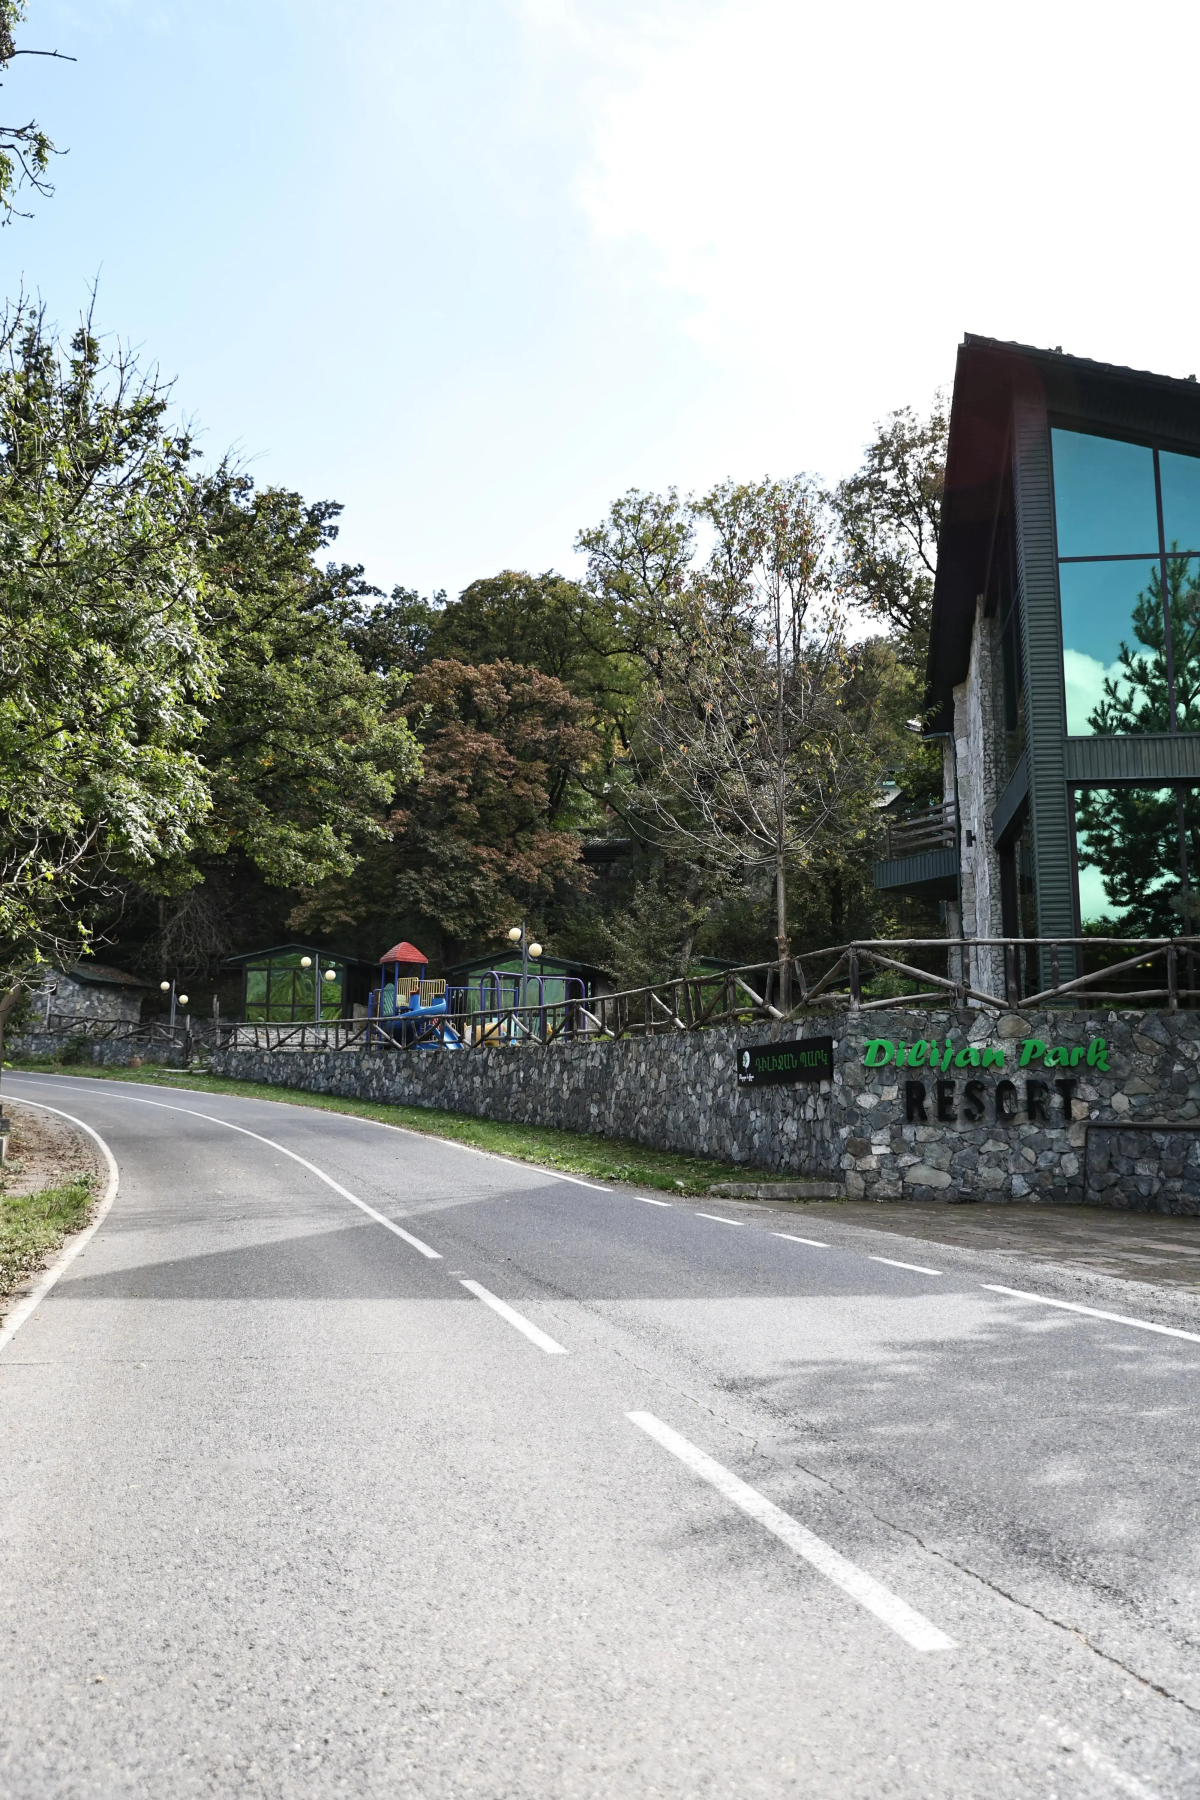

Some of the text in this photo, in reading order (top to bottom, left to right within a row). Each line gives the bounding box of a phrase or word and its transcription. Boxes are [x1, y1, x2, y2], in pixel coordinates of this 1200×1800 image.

[864, 1038, 1111, 1072] Dilijan Park
[905, 1079, 1077, 1122] RESORT
